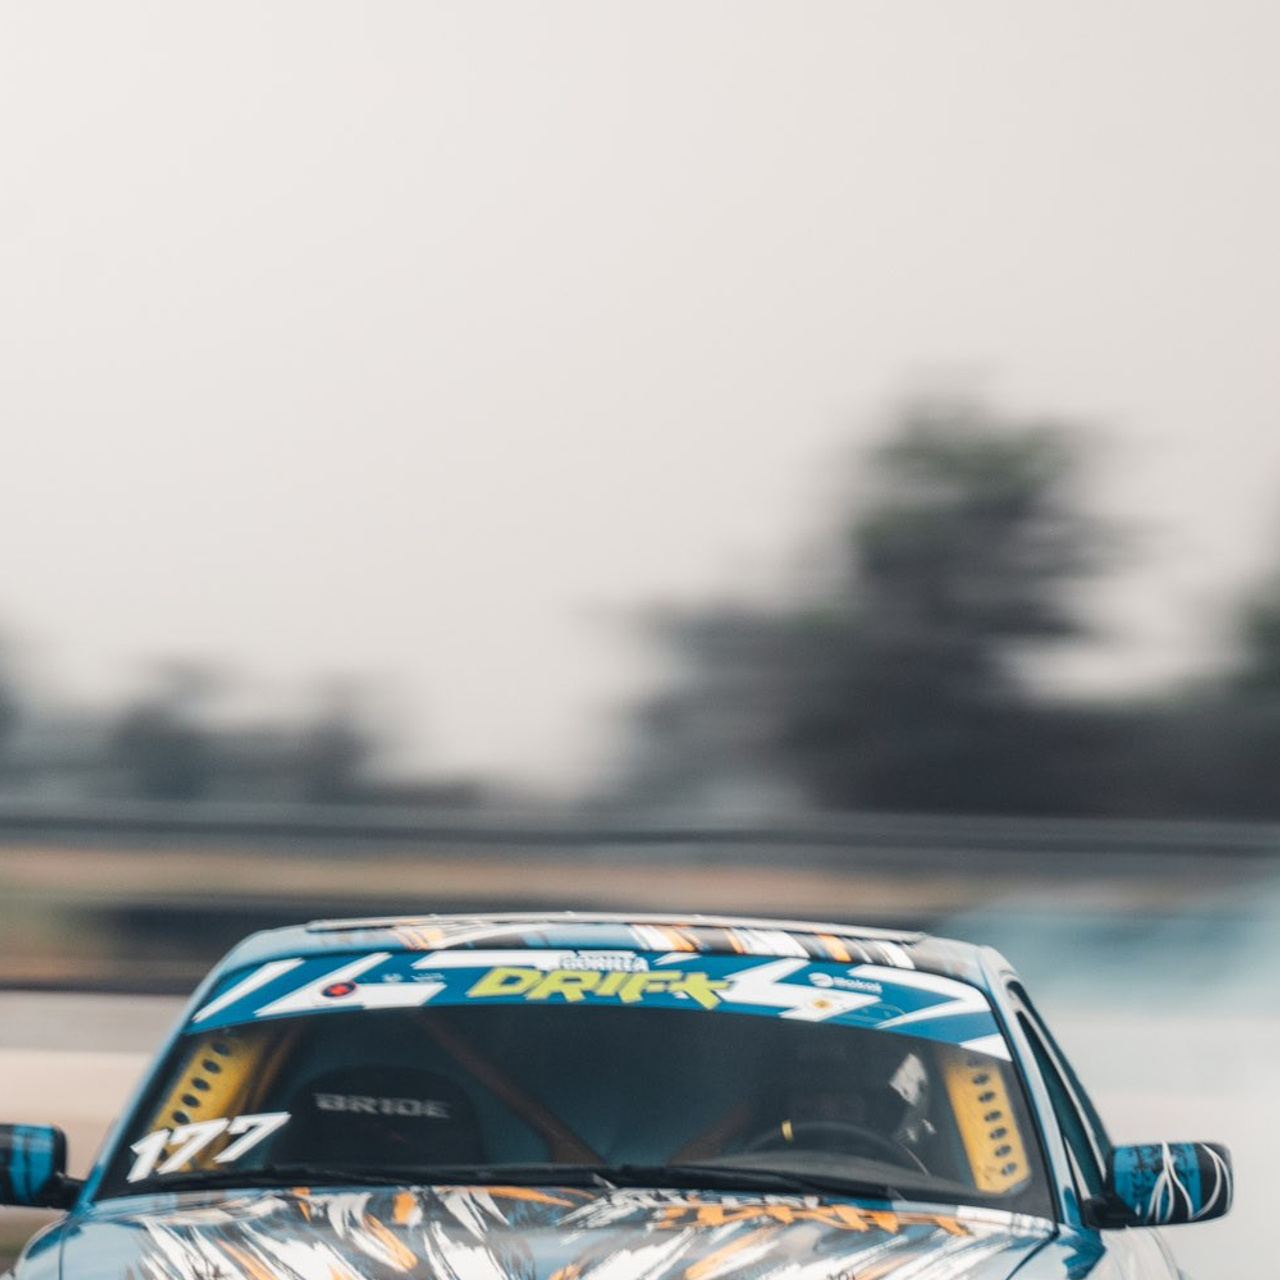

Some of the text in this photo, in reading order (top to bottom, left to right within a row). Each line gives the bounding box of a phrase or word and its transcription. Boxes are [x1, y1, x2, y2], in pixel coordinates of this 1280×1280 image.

[466, 966, 732, 1010] DRIFT
[313, 1092, 452, 1119] BRIDE
[126, 1111, 293, 1184] 177
